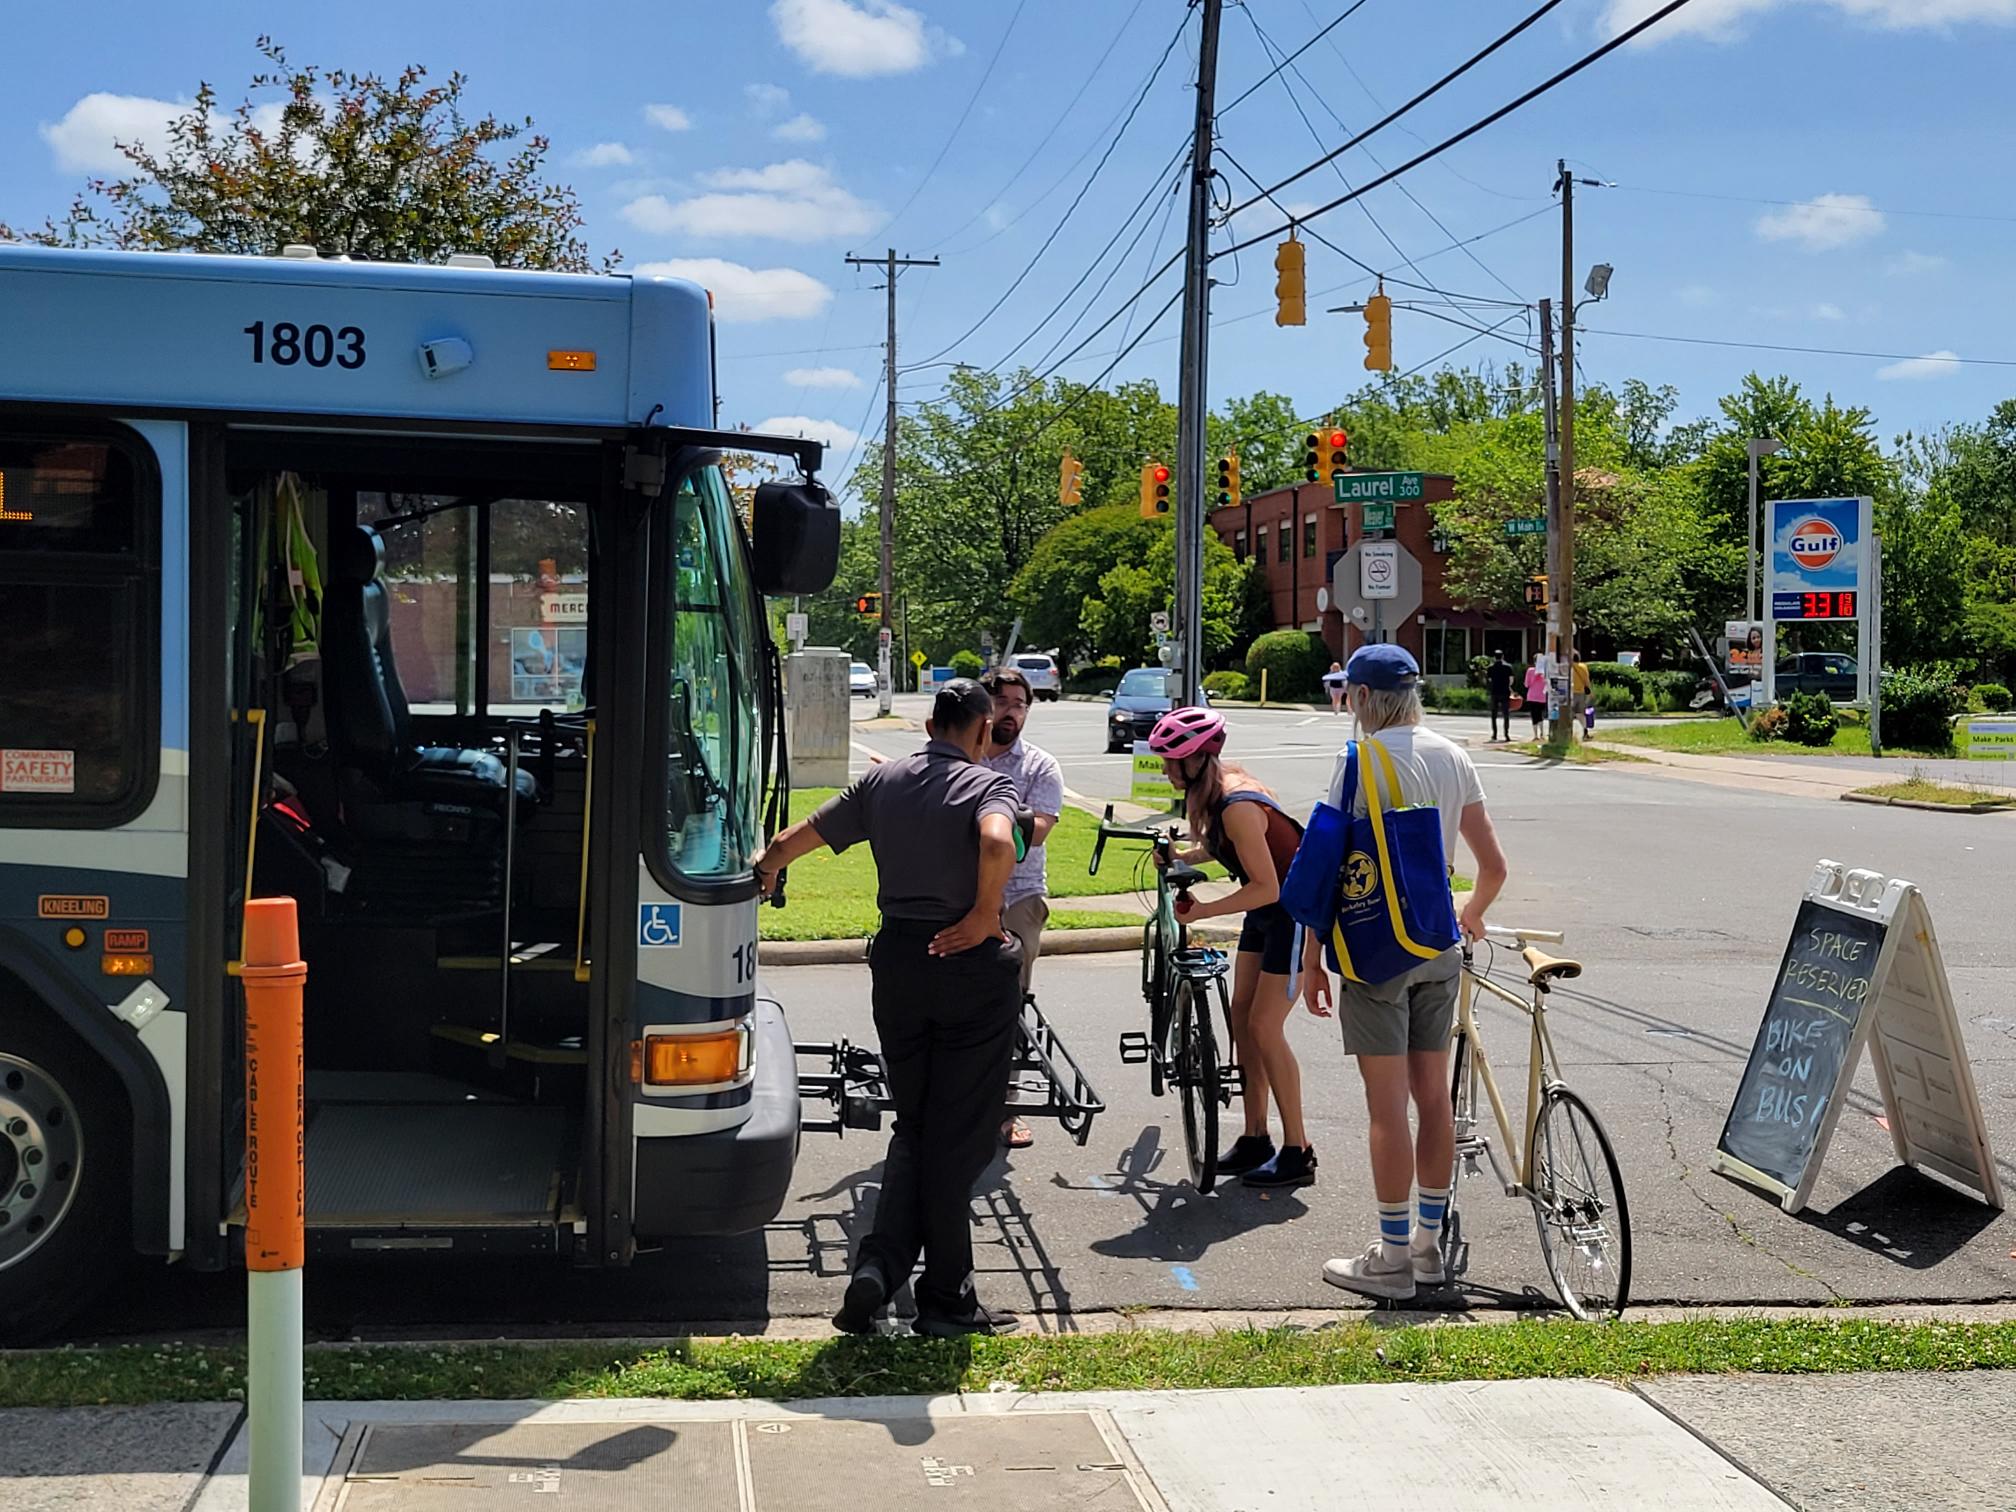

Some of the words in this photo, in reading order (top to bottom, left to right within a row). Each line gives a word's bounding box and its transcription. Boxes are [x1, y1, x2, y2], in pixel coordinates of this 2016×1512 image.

[244, 320, 366, 369] 1803
[1340, 477, 1394, 497] Laurel
[1401, 475, 1418, 485] Ave
[1400, 485, 1420, 496] 300
[1791, 538, 1838, 552] Gulf
[5, 751, 72, 759] COMMUNITY
[6, 761, 72, 775] SAFETY
[5, 775, 74, 784] PARTNERSHIP
[44, 900, 104, 914] KNEELING
[110, 934, 144, 947] RAMP
[1808, 927, 1868, 961] SPACE
[1782, 958, 1868, 1003] RESERVED
[1766, 1019, 1826, 1052] BIKE
[1779, 1055, 1813, 1081] ON
[249, 1058, 258, 1131] CABLE
[249, 1135, 258, 1208] ROUTE
